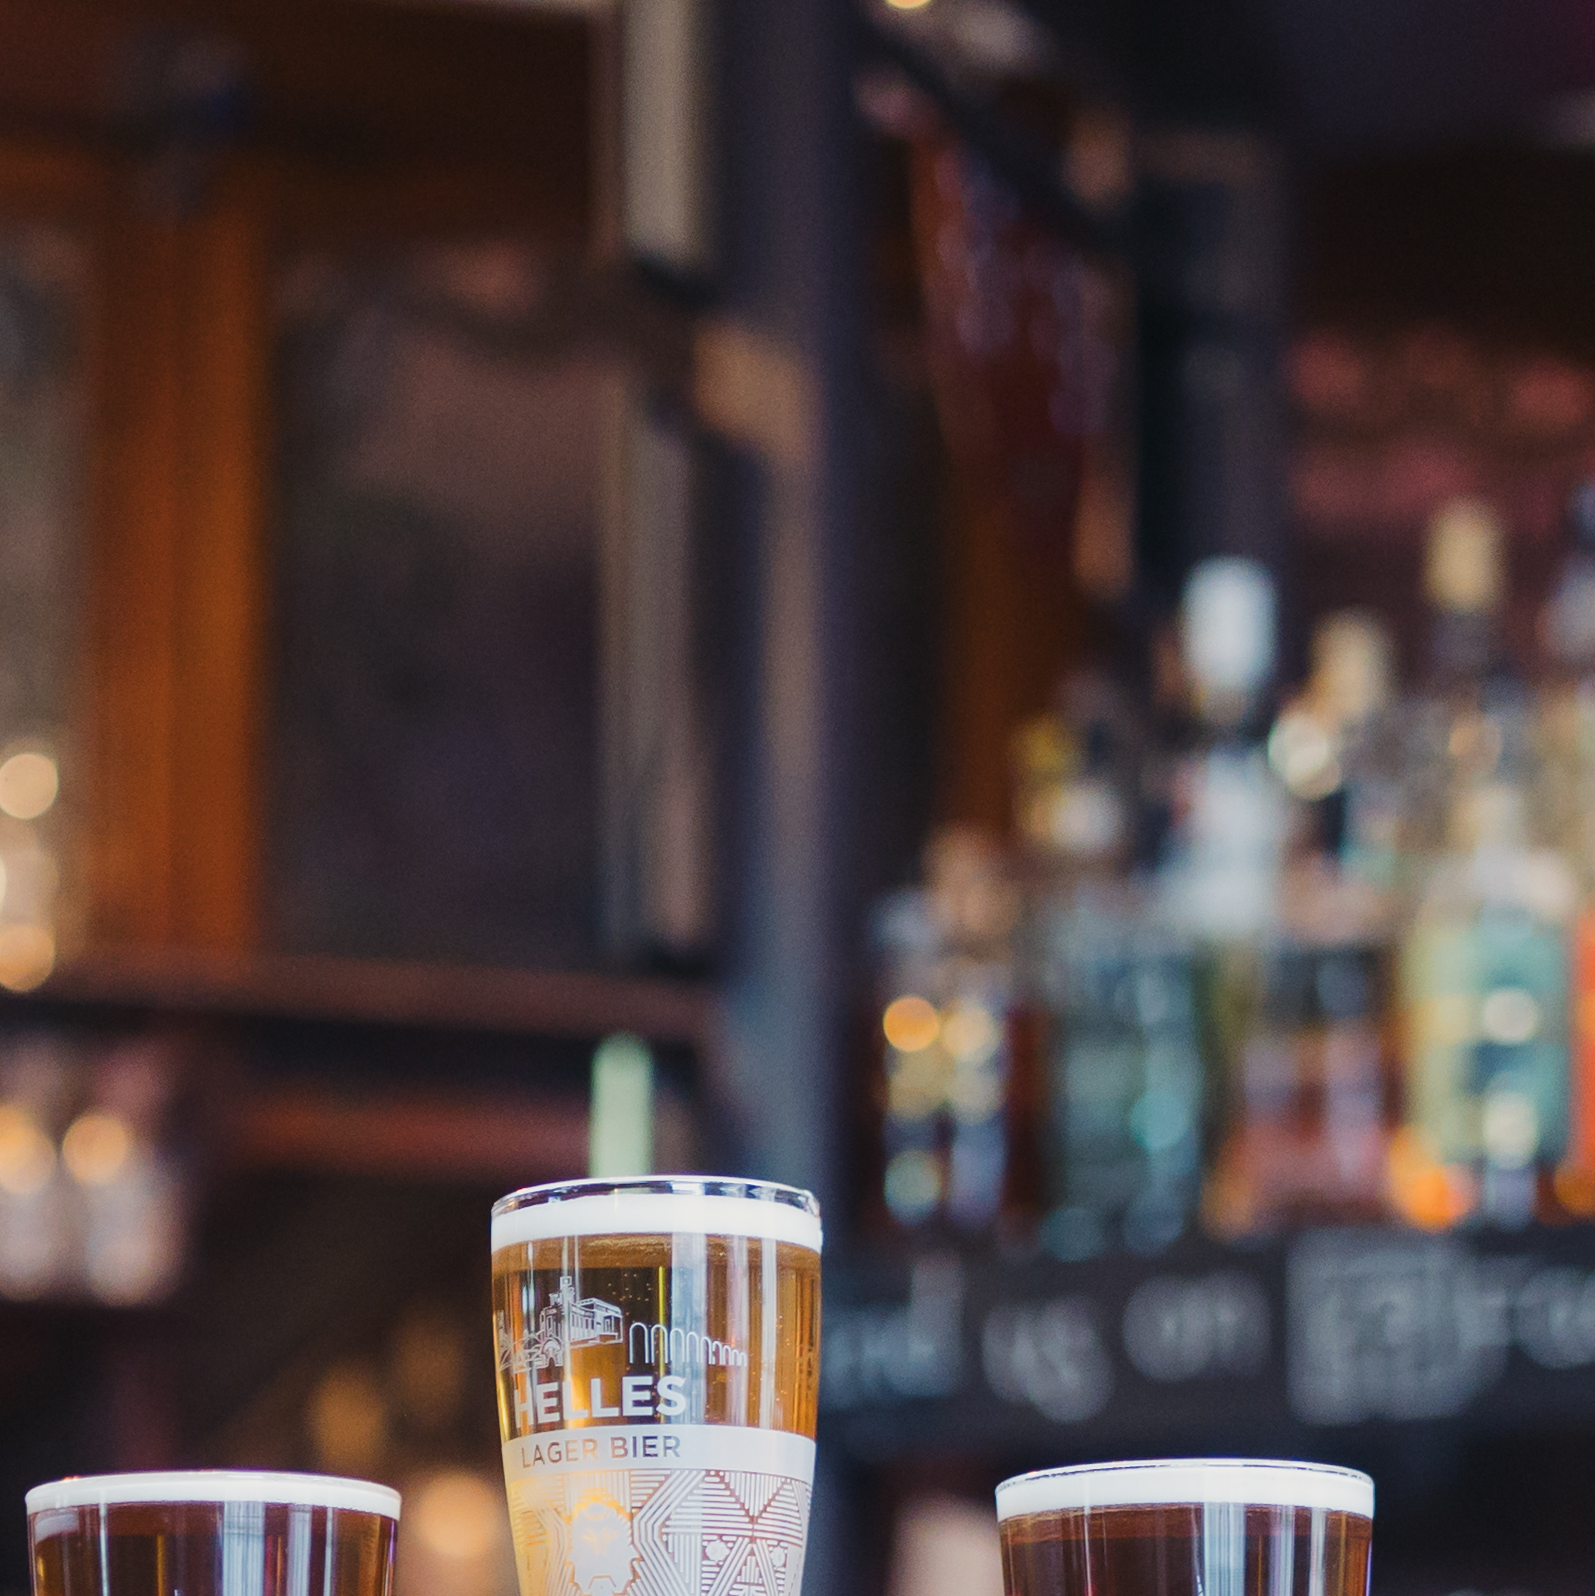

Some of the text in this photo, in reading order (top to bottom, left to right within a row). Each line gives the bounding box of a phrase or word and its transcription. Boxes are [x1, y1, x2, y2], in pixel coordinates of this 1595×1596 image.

[514, 1374, 687, 1429] HELLES
[521, 1435, 681, 1468] LAGER BIER
